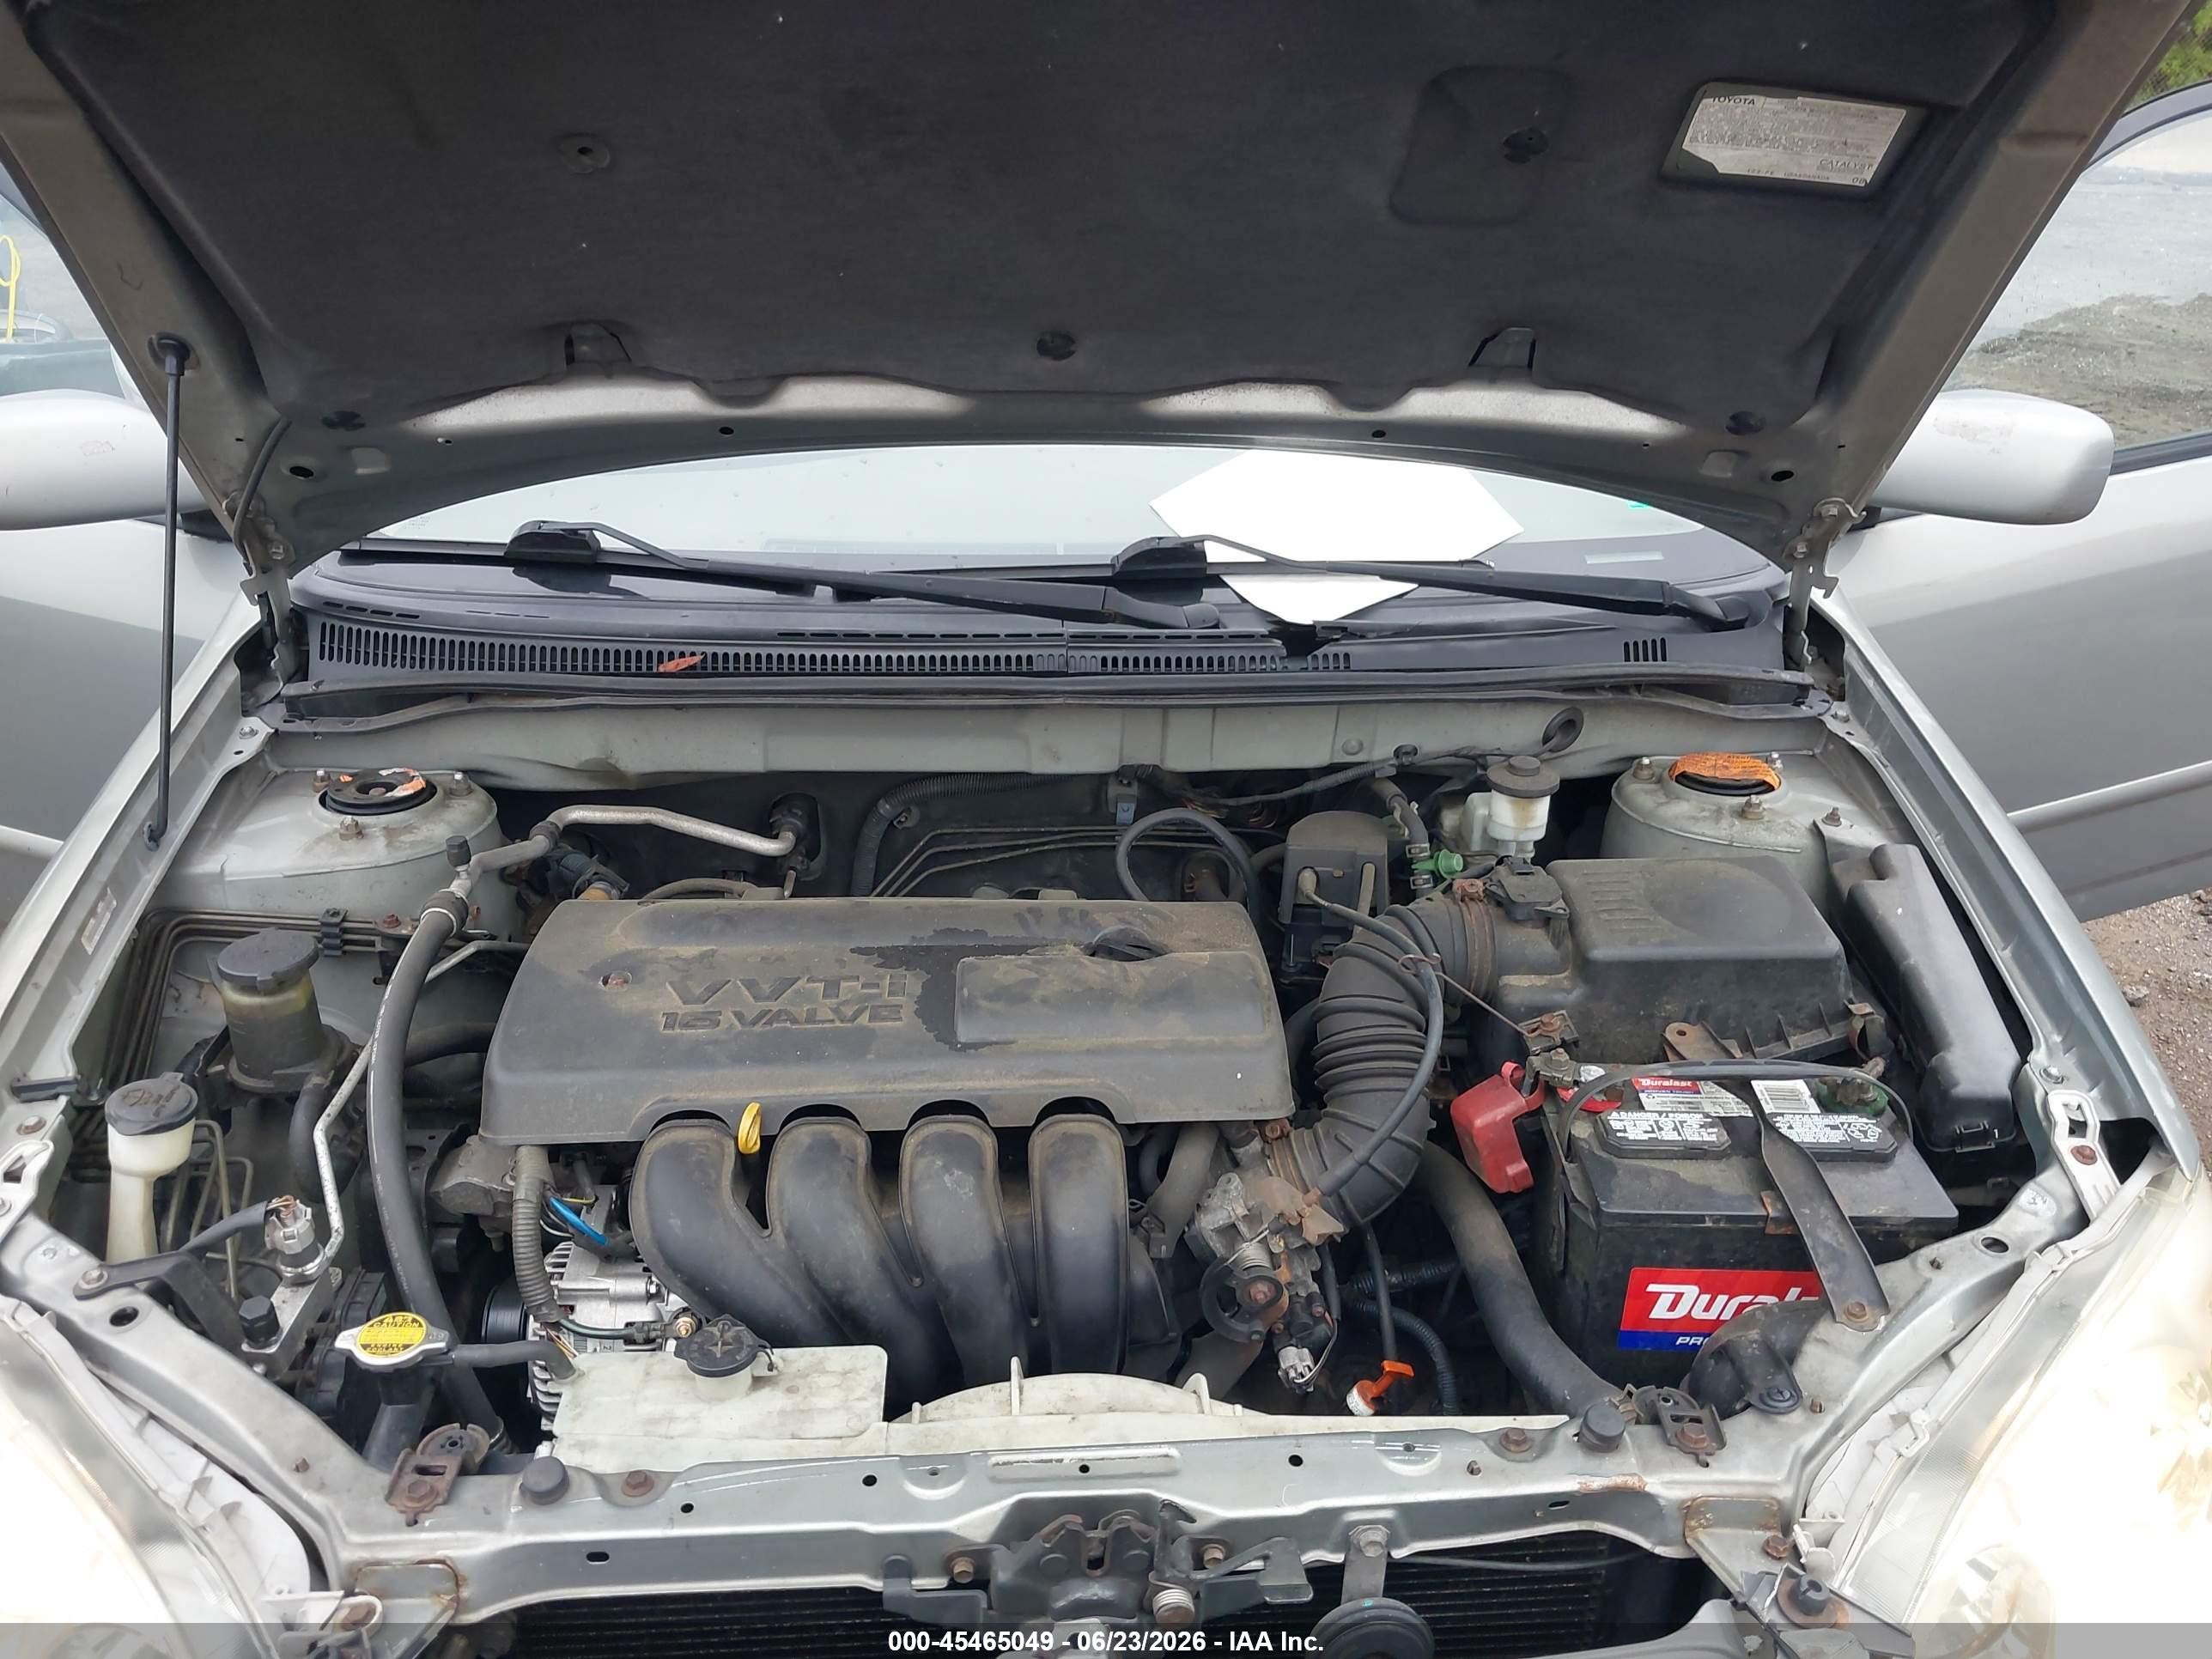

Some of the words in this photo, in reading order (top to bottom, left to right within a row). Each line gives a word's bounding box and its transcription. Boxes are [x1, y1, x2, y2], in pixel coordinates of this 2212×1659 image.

[1712, 96, 1756, 105] TOYOTA
[1820, 158, 1873, 171] CATALYST
[661, 1011, 722, 1030] 16
[732, 1003, 904, 1029] VALVE
[1638, 1079, 1692, 1087] Duralast
